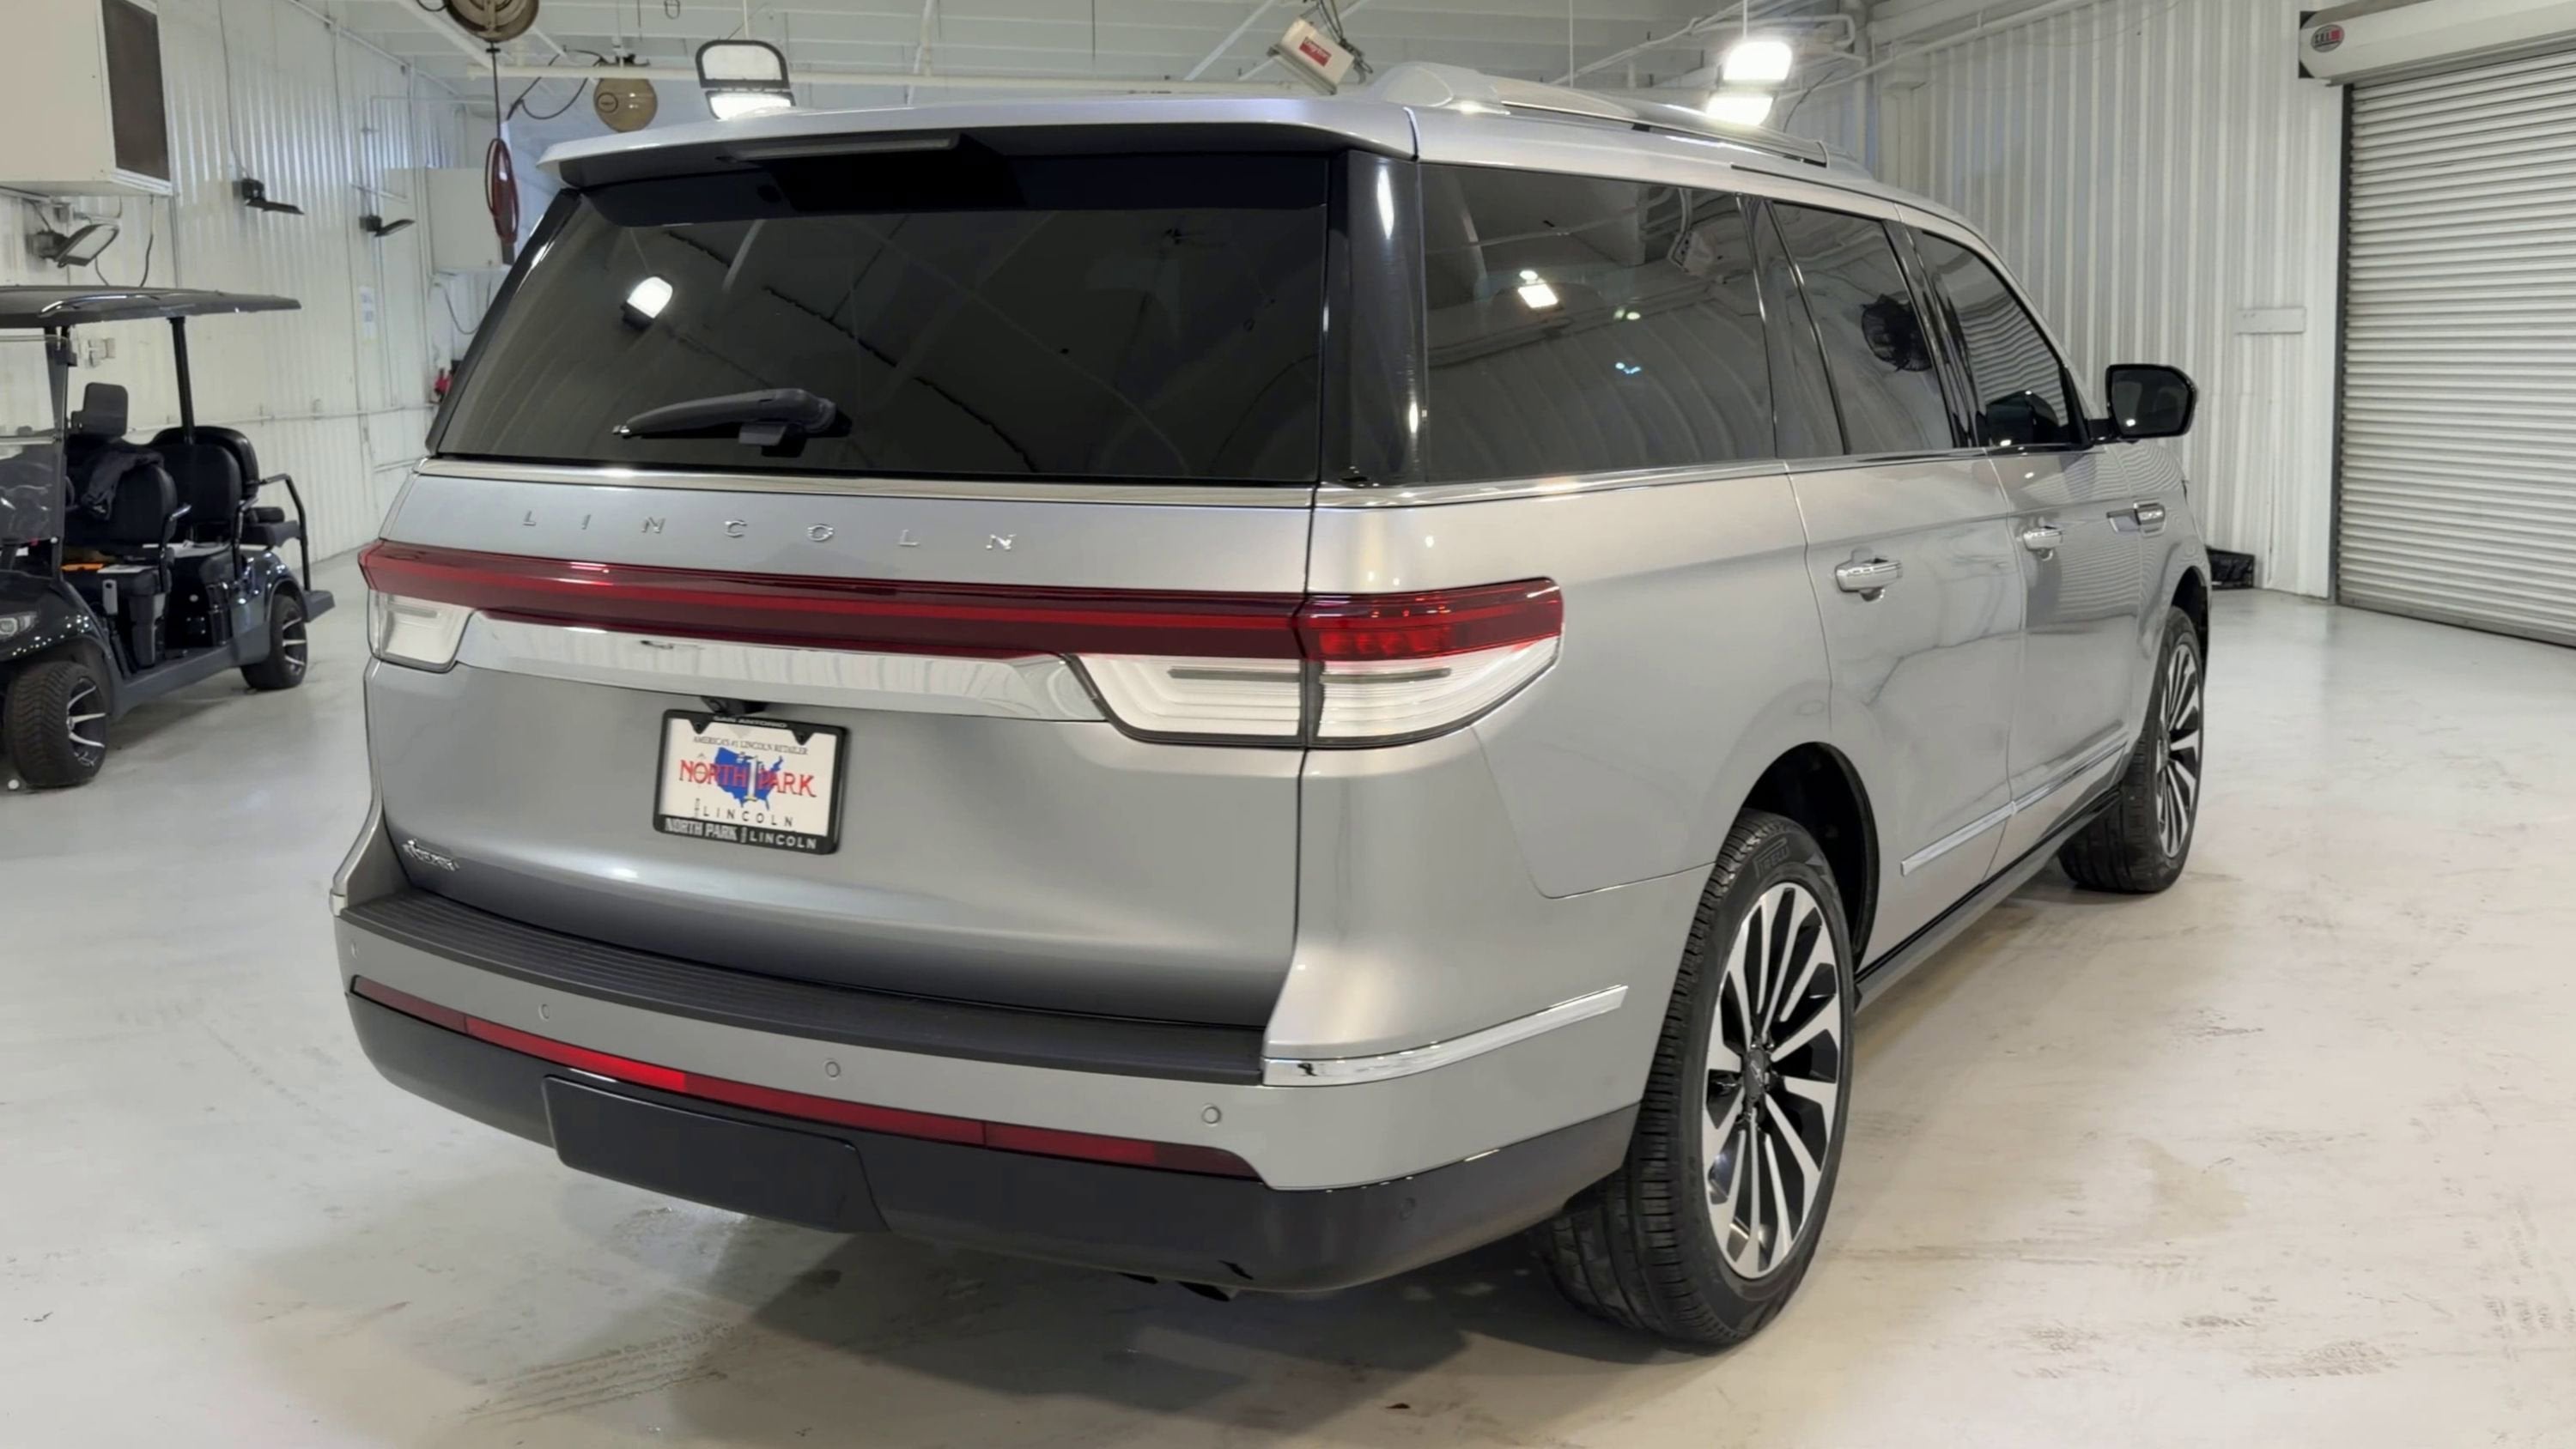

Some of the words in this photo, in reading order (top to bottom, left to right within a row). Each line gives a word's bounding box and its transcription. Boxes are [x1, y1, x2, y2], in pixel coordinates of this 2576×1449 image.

[522, 510, 1018, 551] LINCOLN
[739, 740, 773, 751] LINCOLN
[679, 760, 746, 787] NORTH
[757, 767, 817, 798] PARK
[702, 804, 794, 828] LINCOLN
[665, 817, 703, 835] NORTH
[705, 822, 738, 840] PARK
[750, 831, 817, 849] LINCOLN
